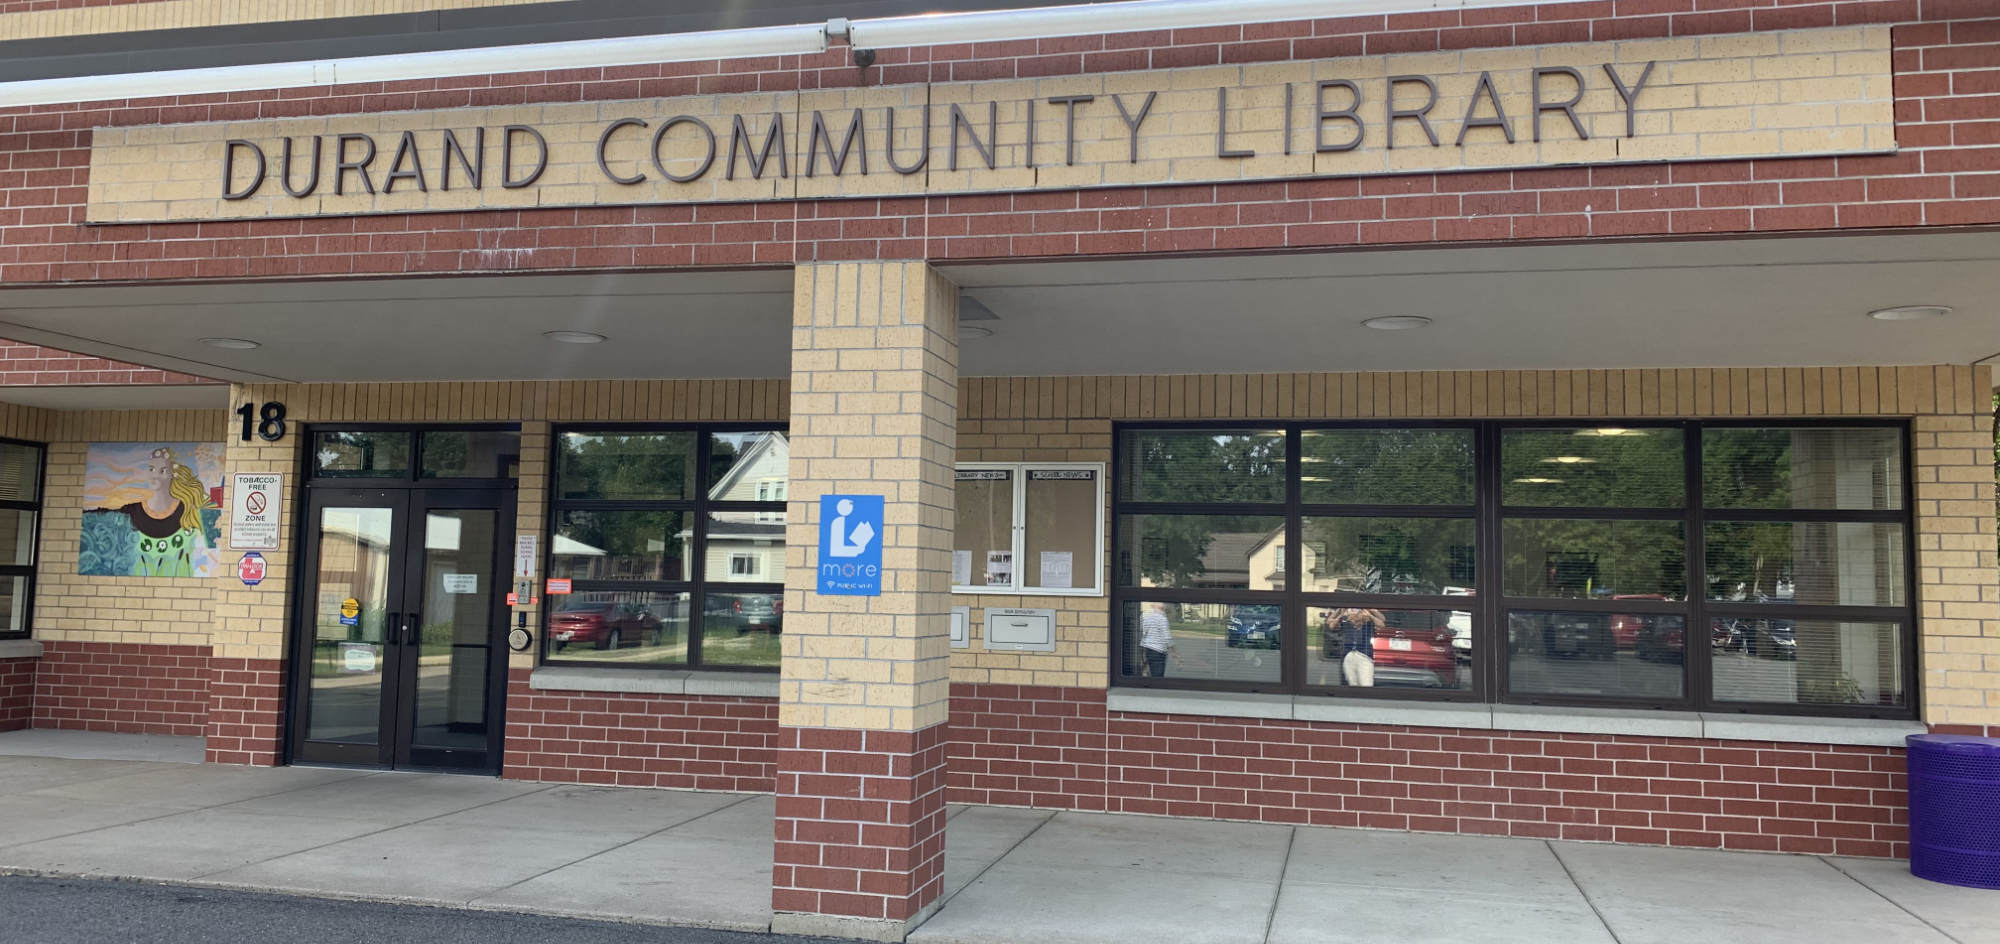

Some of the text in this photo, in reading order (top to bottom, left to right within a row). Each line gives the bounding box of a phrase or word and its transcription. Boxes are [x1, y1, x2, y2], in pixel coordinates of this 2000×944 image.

[221, 60, 1657, 201] DURAND COMMUNITY LIBRARY
[237, 402, 286, 442] 18
[822, 563, 877, 578] more
